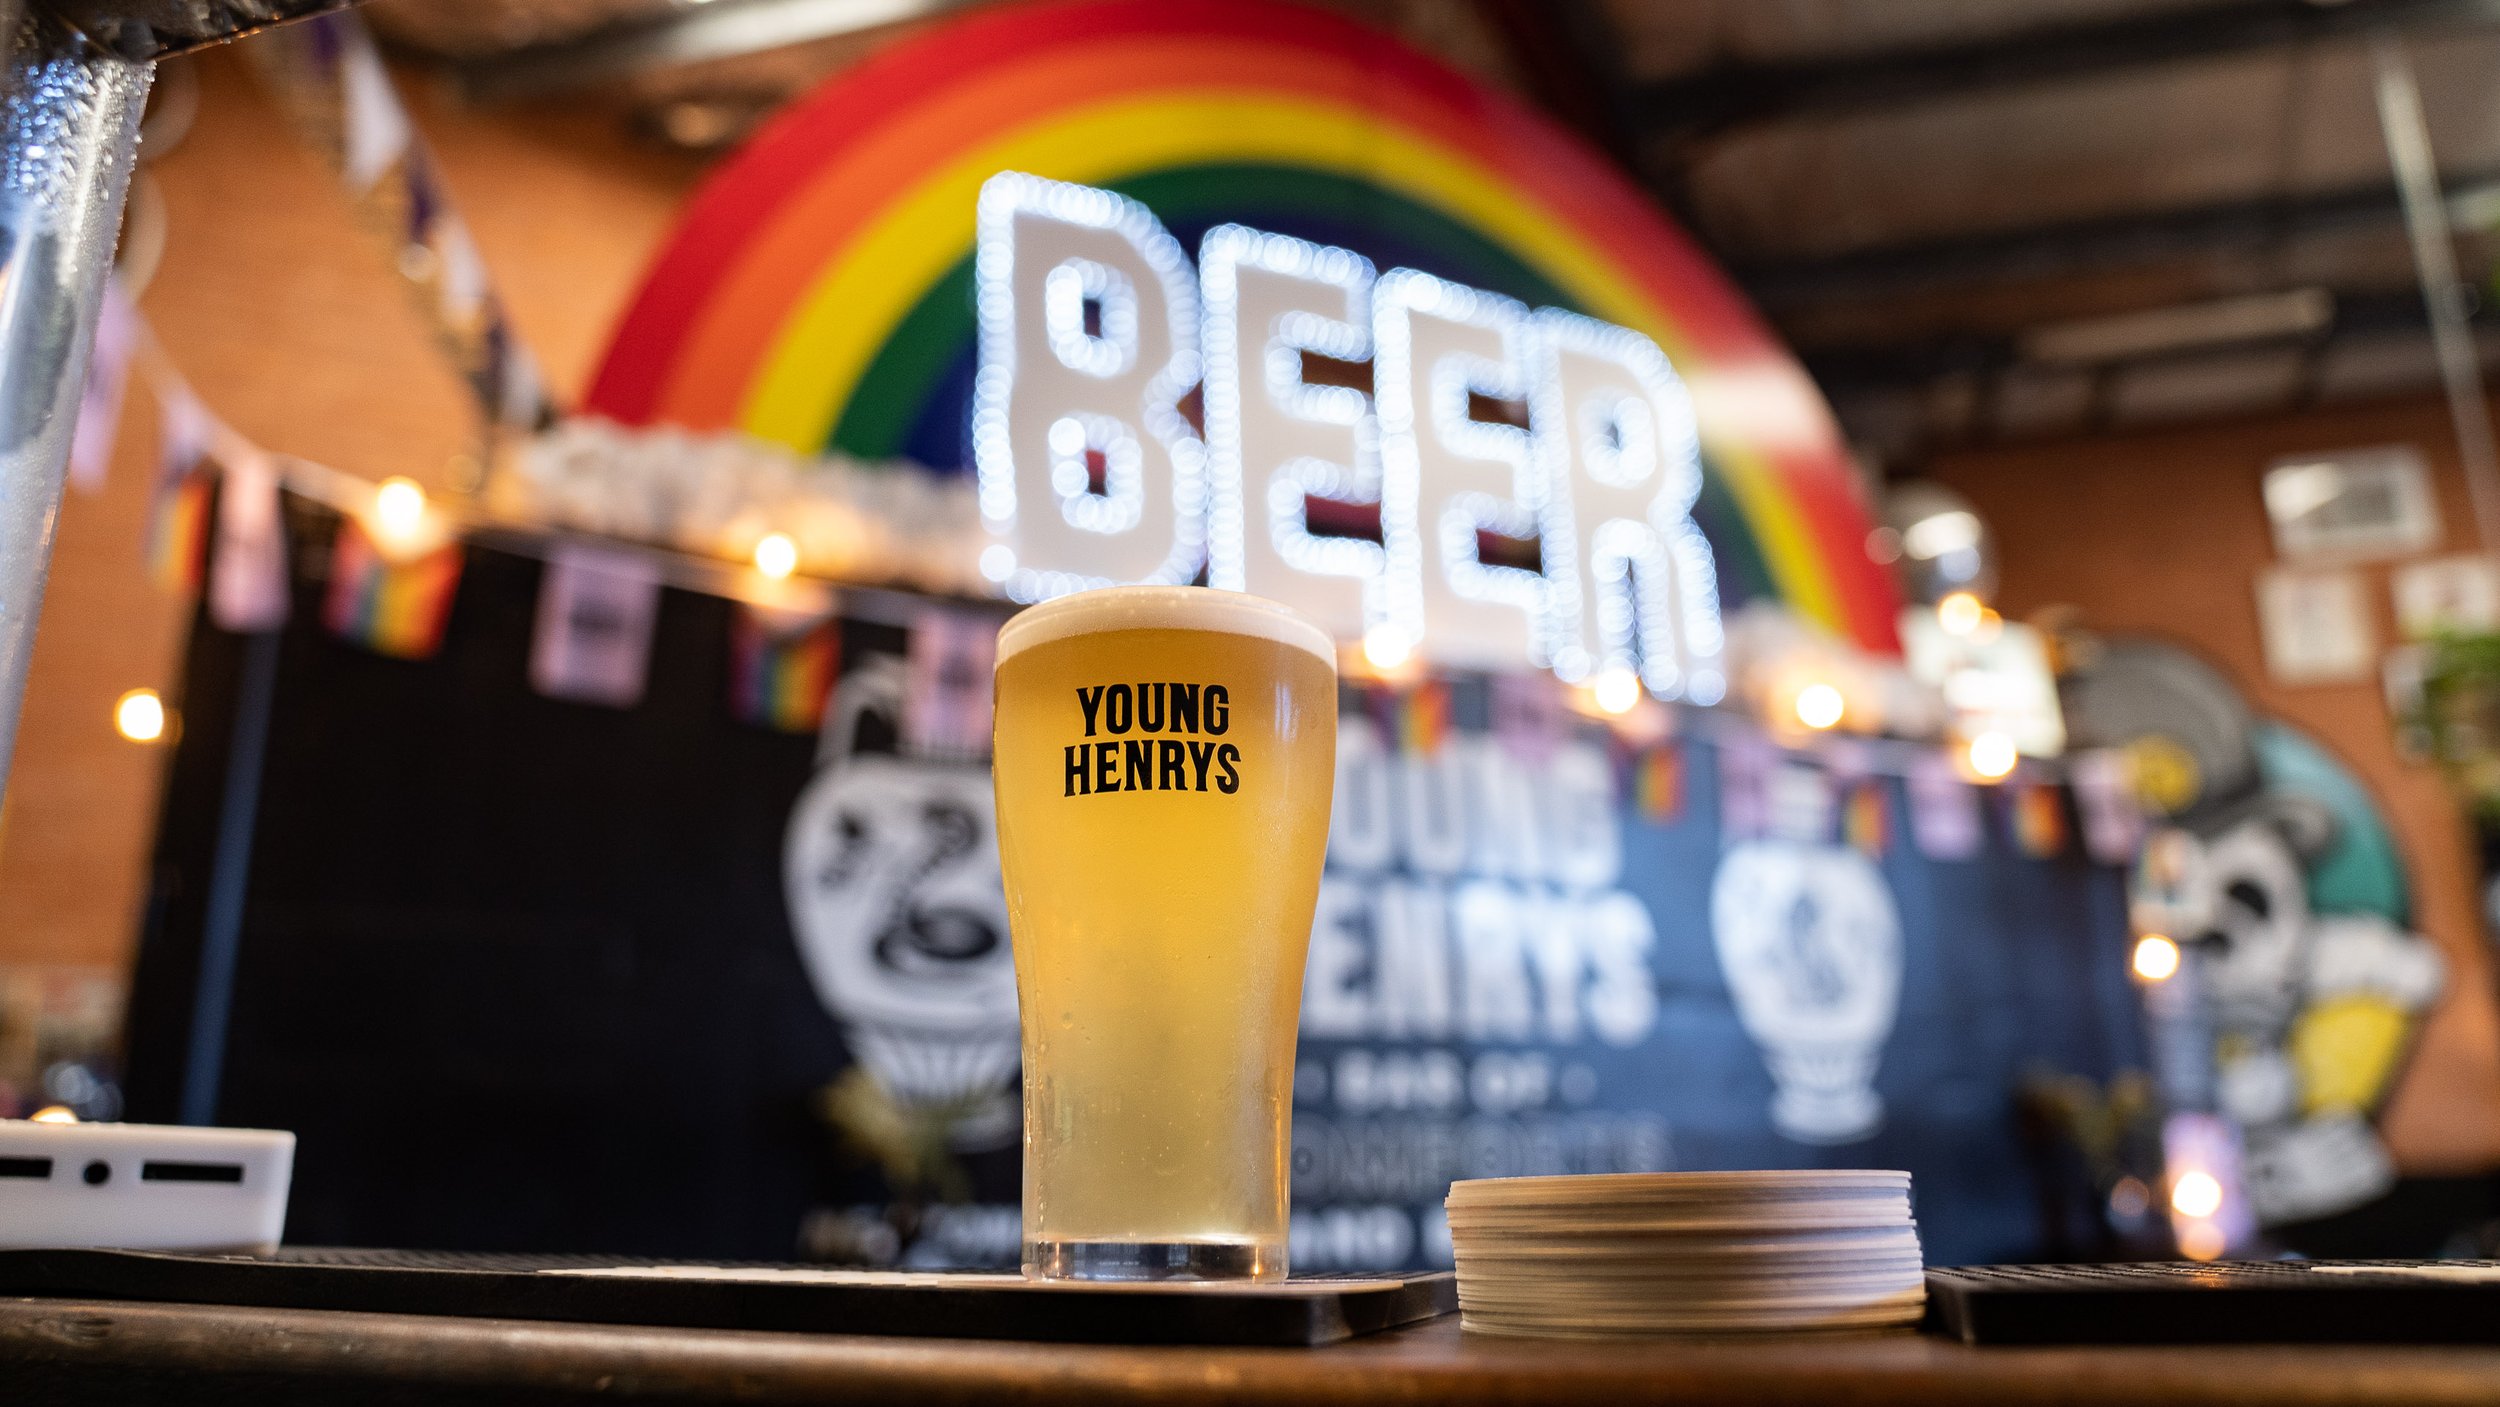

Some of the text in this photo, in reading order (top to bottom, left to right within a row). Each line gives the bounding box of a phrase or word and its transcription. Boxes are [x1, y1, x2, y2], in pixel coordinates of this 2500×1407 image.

[974, 169, 1726, 705] BEER
[1063, 739, 1242, 798] HENRYS
[1075, 682, 1230, 737] YOUNG
[1330, 712, 1622, 886] OUNG
[1300, 878, 1660, 1046] ENRYS
